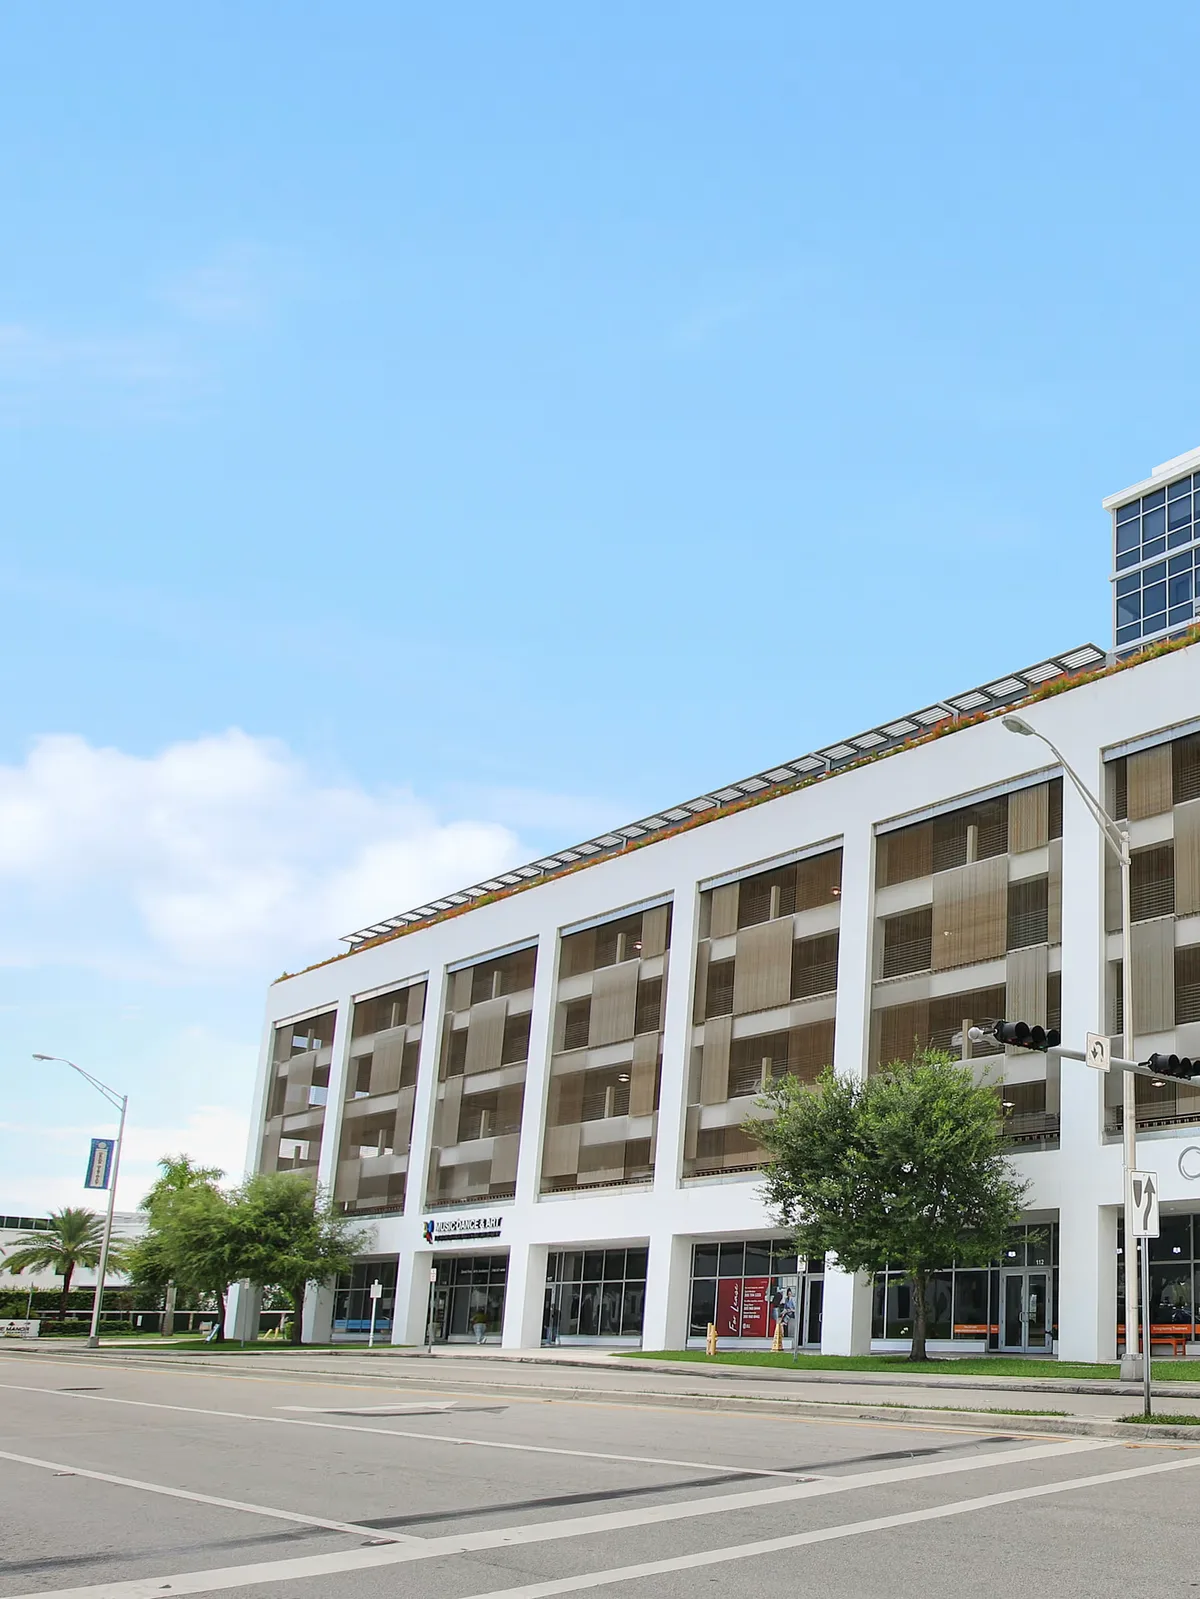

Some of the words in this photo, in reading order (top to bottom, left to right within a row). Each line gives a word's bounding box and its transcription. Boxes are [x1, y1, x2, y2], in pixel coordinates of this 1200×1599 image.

[486, 1217, 502, 1228] ART
[730, 1283, 740, 1313] Lease
[728, 1315, 738, 1332] For
